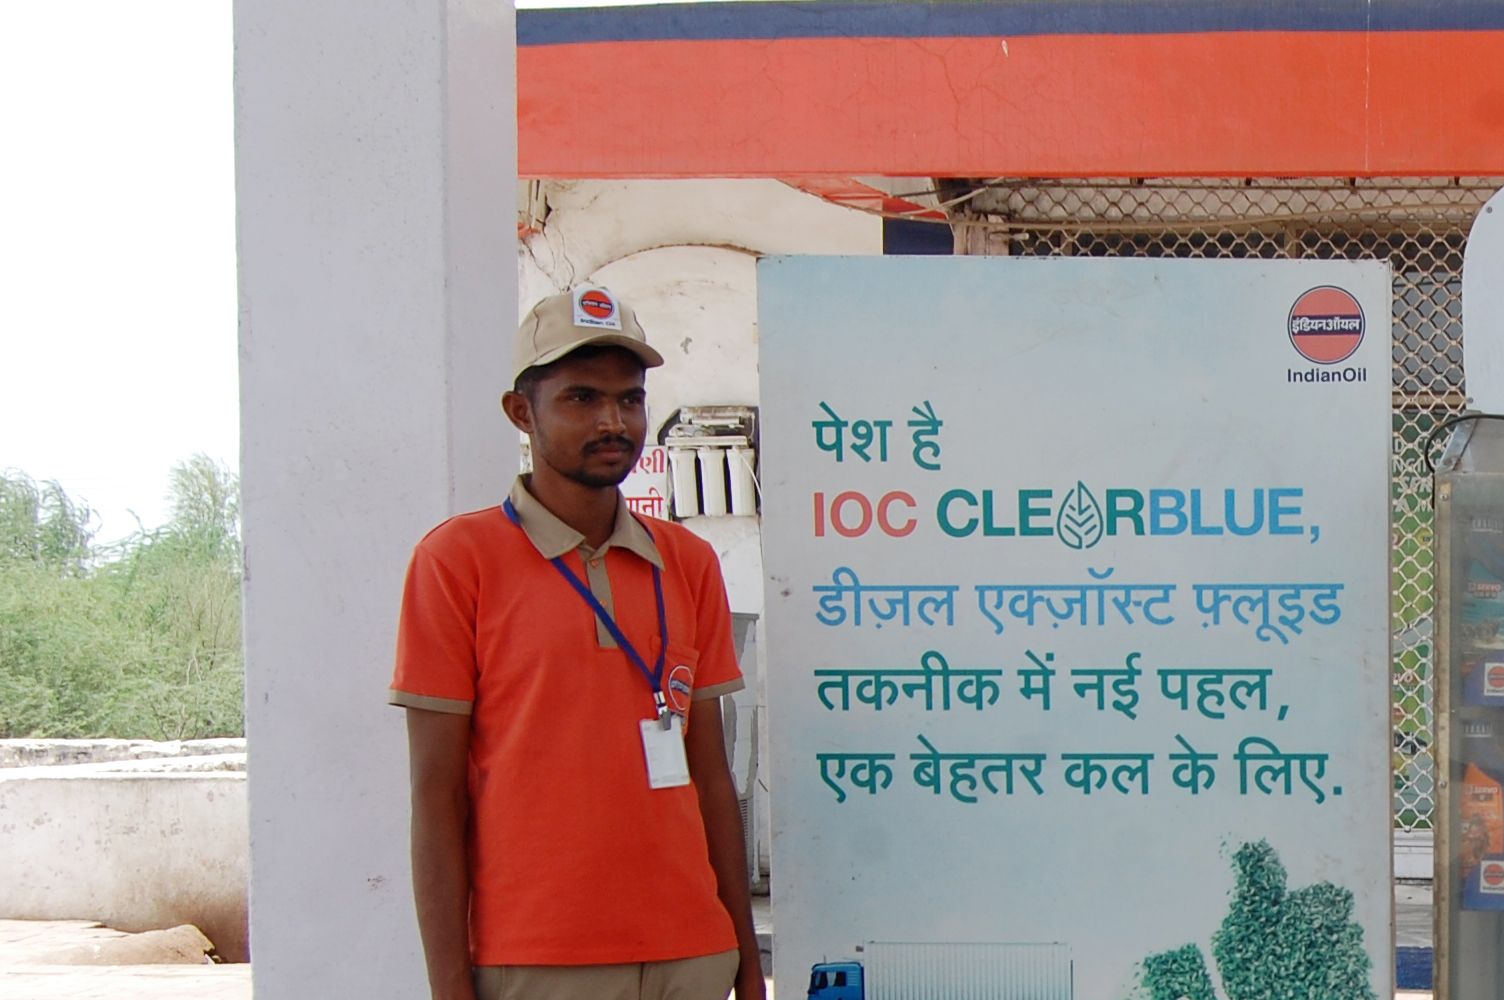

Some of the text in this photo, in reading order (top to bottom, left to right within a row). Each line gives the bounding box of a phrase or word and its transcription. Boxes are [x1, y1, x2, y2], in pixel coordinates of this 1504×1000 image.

[1292, 316, 1361, 334] इंडियनऑयल
[1287, 367, 1367, 383] IndianOil
[812, 401, 943, 470] पेश है
[813, 490, 917, 538] IOC
[813, 566, 959, 628] डीज़ल
[975, 567, 1176, 634] एक्ज़ॉस्ट
[814, 650, 1290, 721] तकनीक में नई पहल,
[816, 734, 1344, 804] एक बेहतर कल के लिए.
